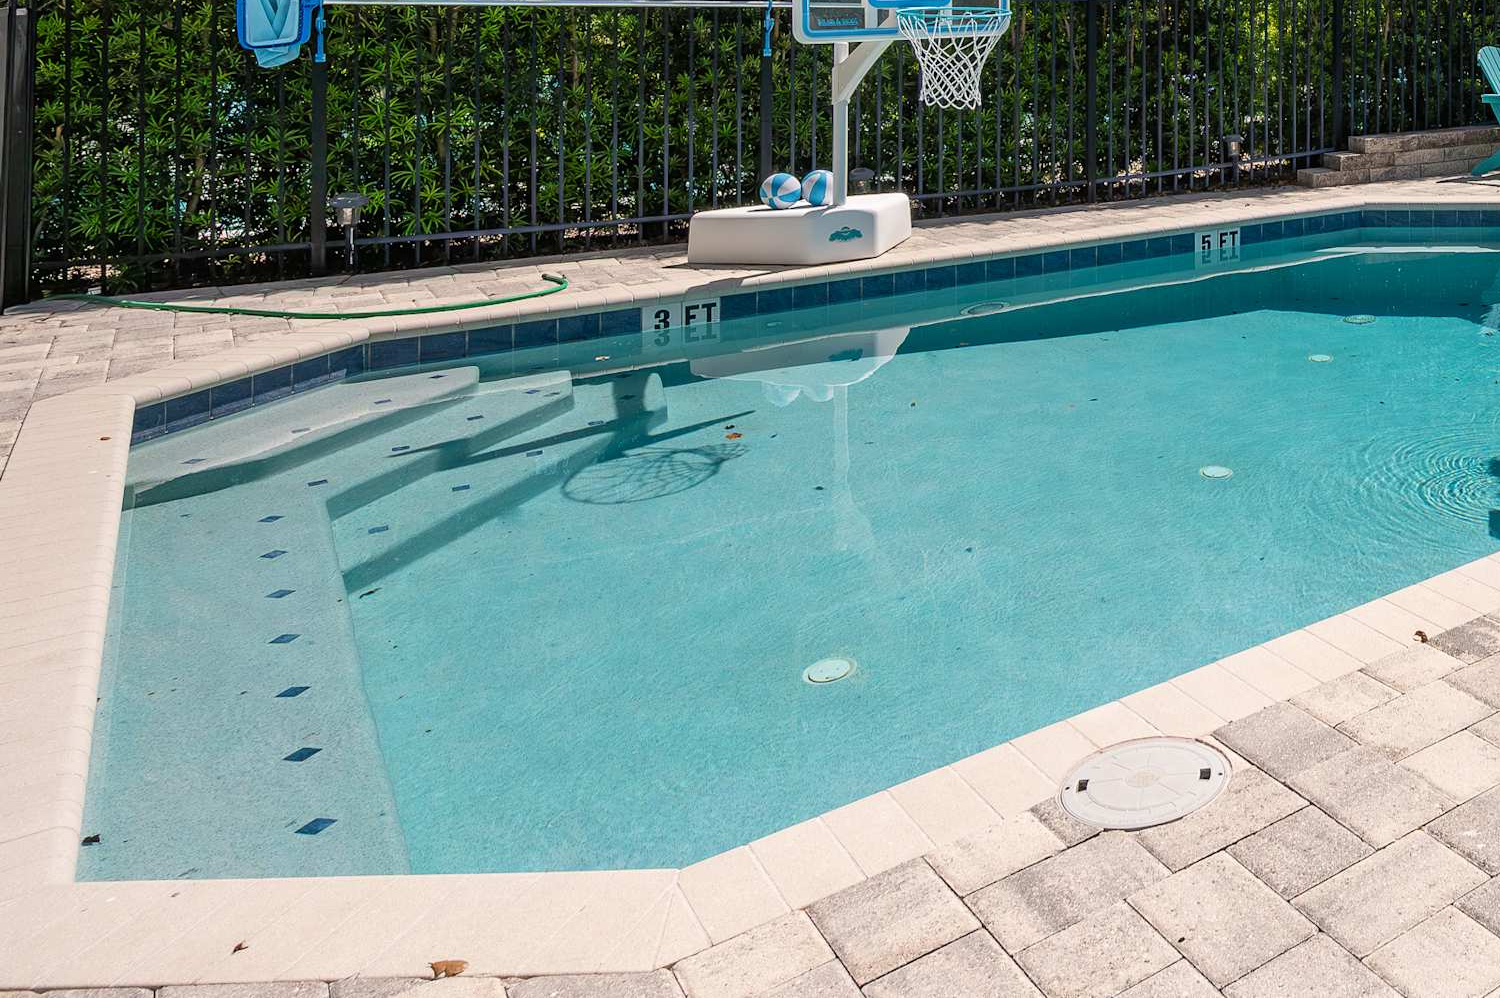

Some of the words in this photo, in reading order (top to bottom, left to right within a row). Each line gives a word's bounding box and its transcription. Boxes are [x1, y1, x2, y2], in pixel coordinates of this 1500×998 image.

[1202, 234, 1211, 250] 5
[1220, 230, 1238, 248] FT
[654, 309, 670, 330] 3
[685, 302, 717, 326] FT
